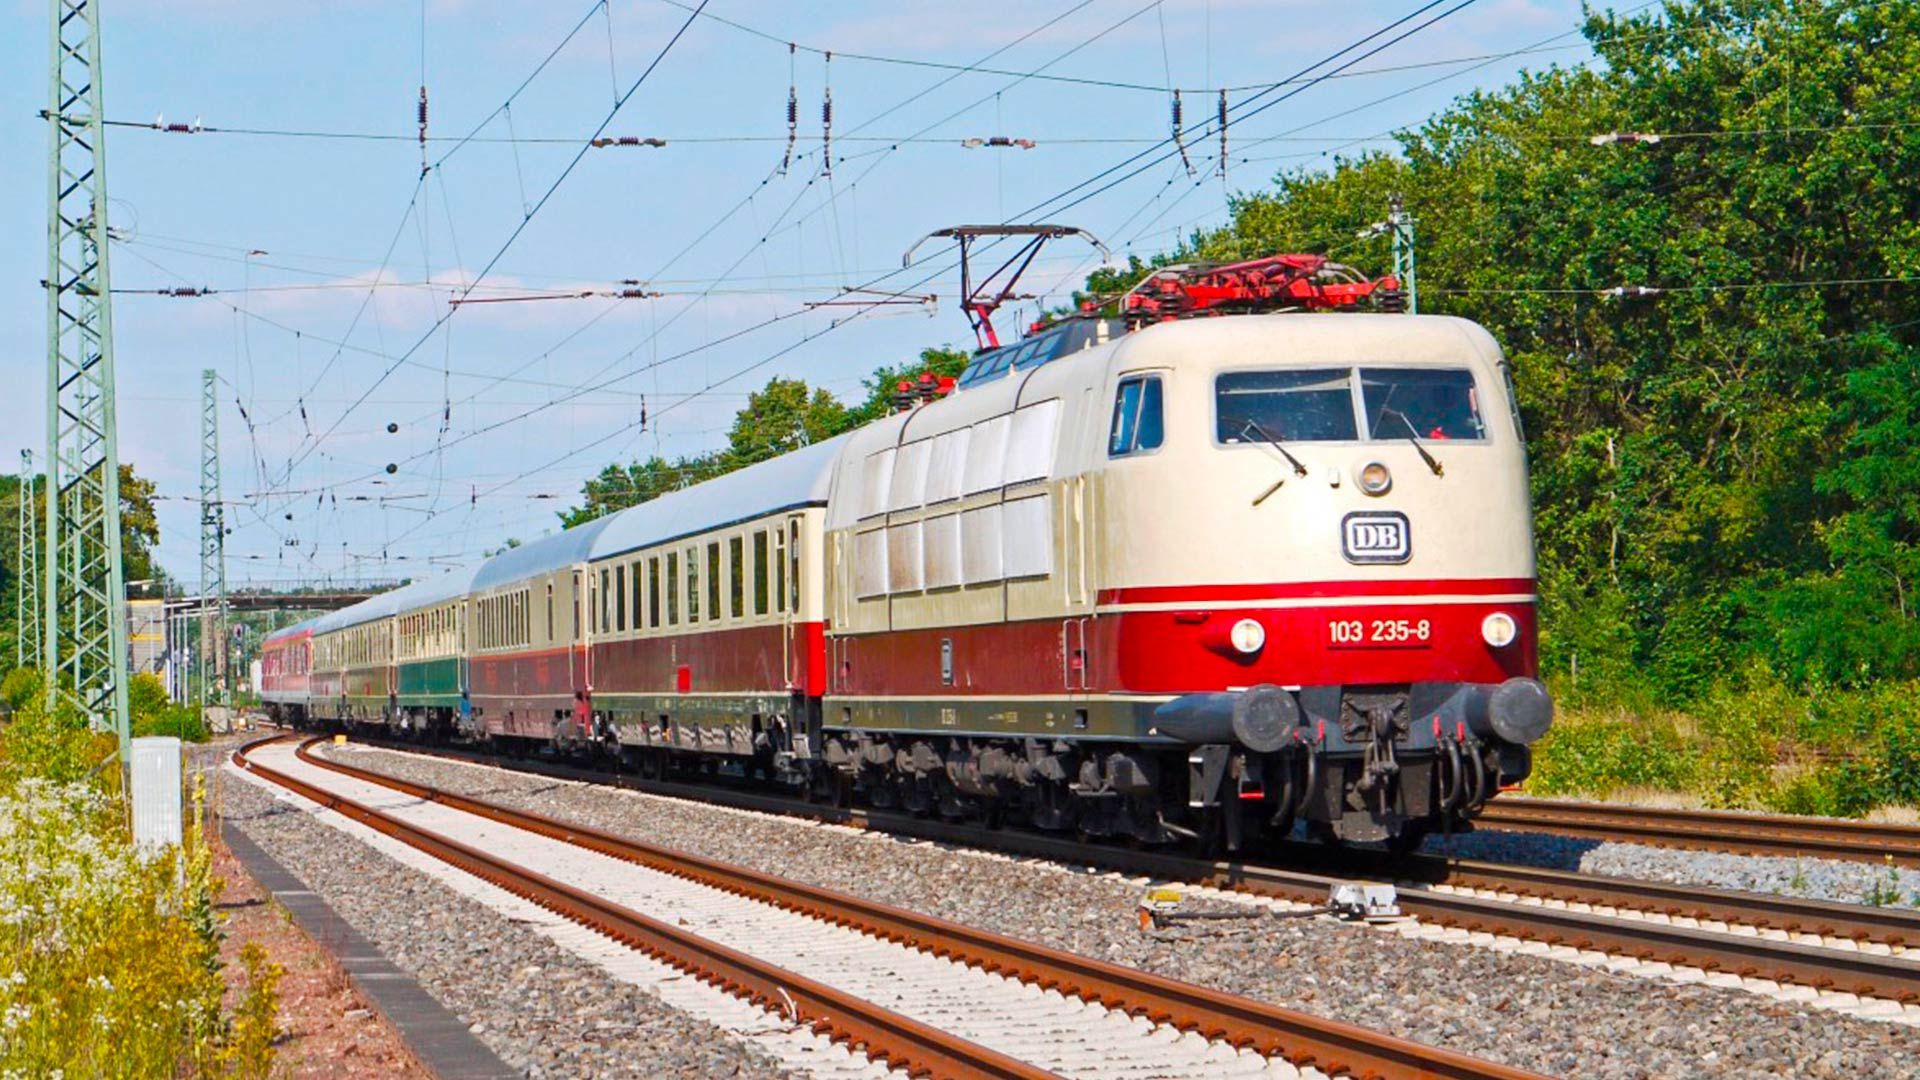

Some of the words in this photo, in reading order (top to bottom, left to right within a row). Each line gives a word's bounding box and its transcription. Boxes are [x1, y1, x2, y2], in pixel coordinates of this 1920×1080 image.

[1353, 524, 1398, 549] DB
[1329, 620, 1363, 642] 103
[1371, 619, 1430, 641] 235-8
